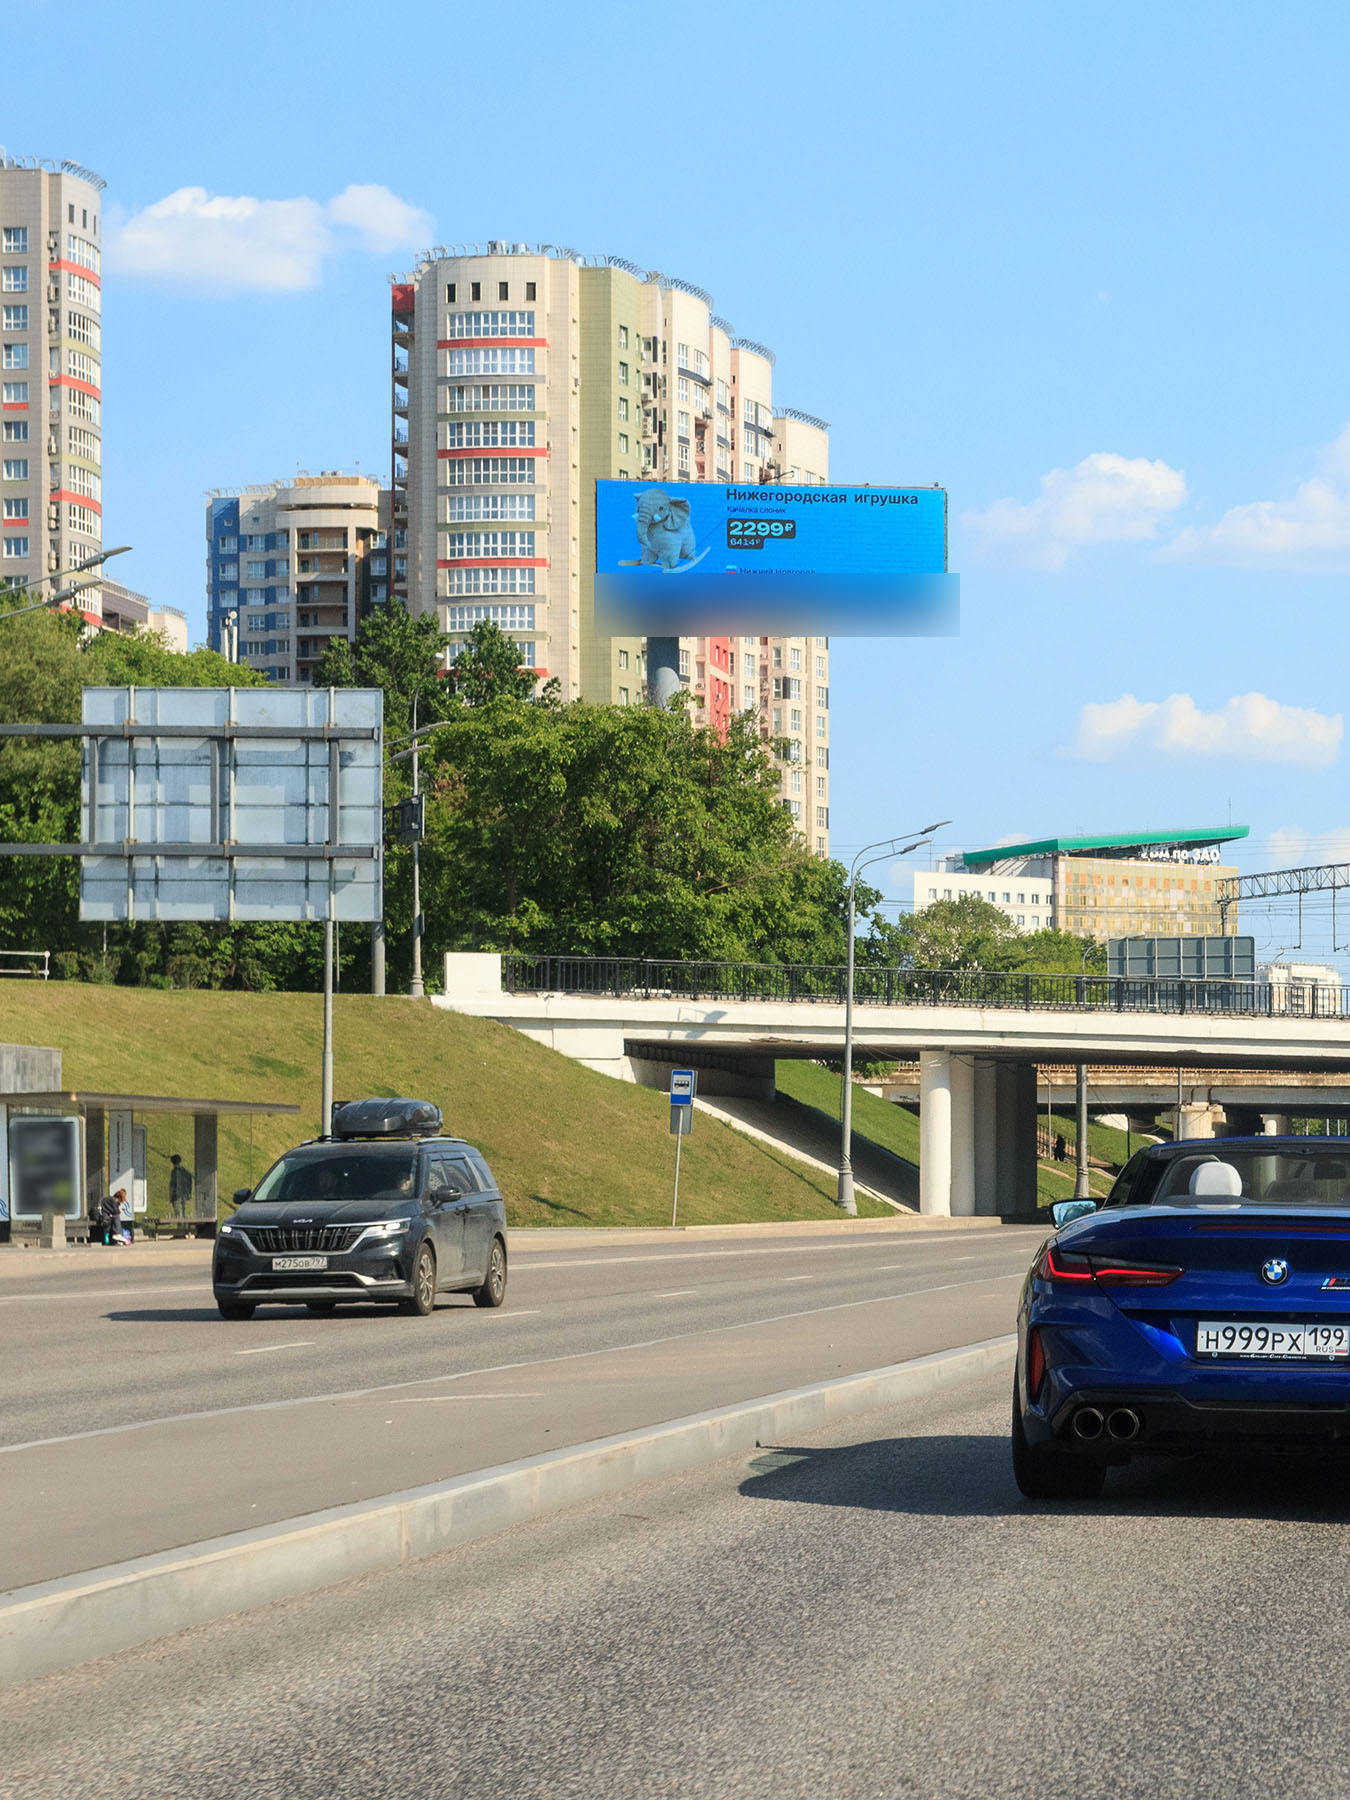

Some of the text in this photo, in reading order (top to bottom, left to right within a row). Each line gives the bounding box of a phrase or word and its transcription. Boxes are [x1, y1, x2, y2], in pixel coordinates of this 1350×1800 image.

[726, 488, 918, 506] Нижегородская игрушка
[1173, 849, 1188, 859] по
[1192, 848, 1220, 862] ЗАО
[1206, 1326, 1344, 1351] Н999РХ 199
